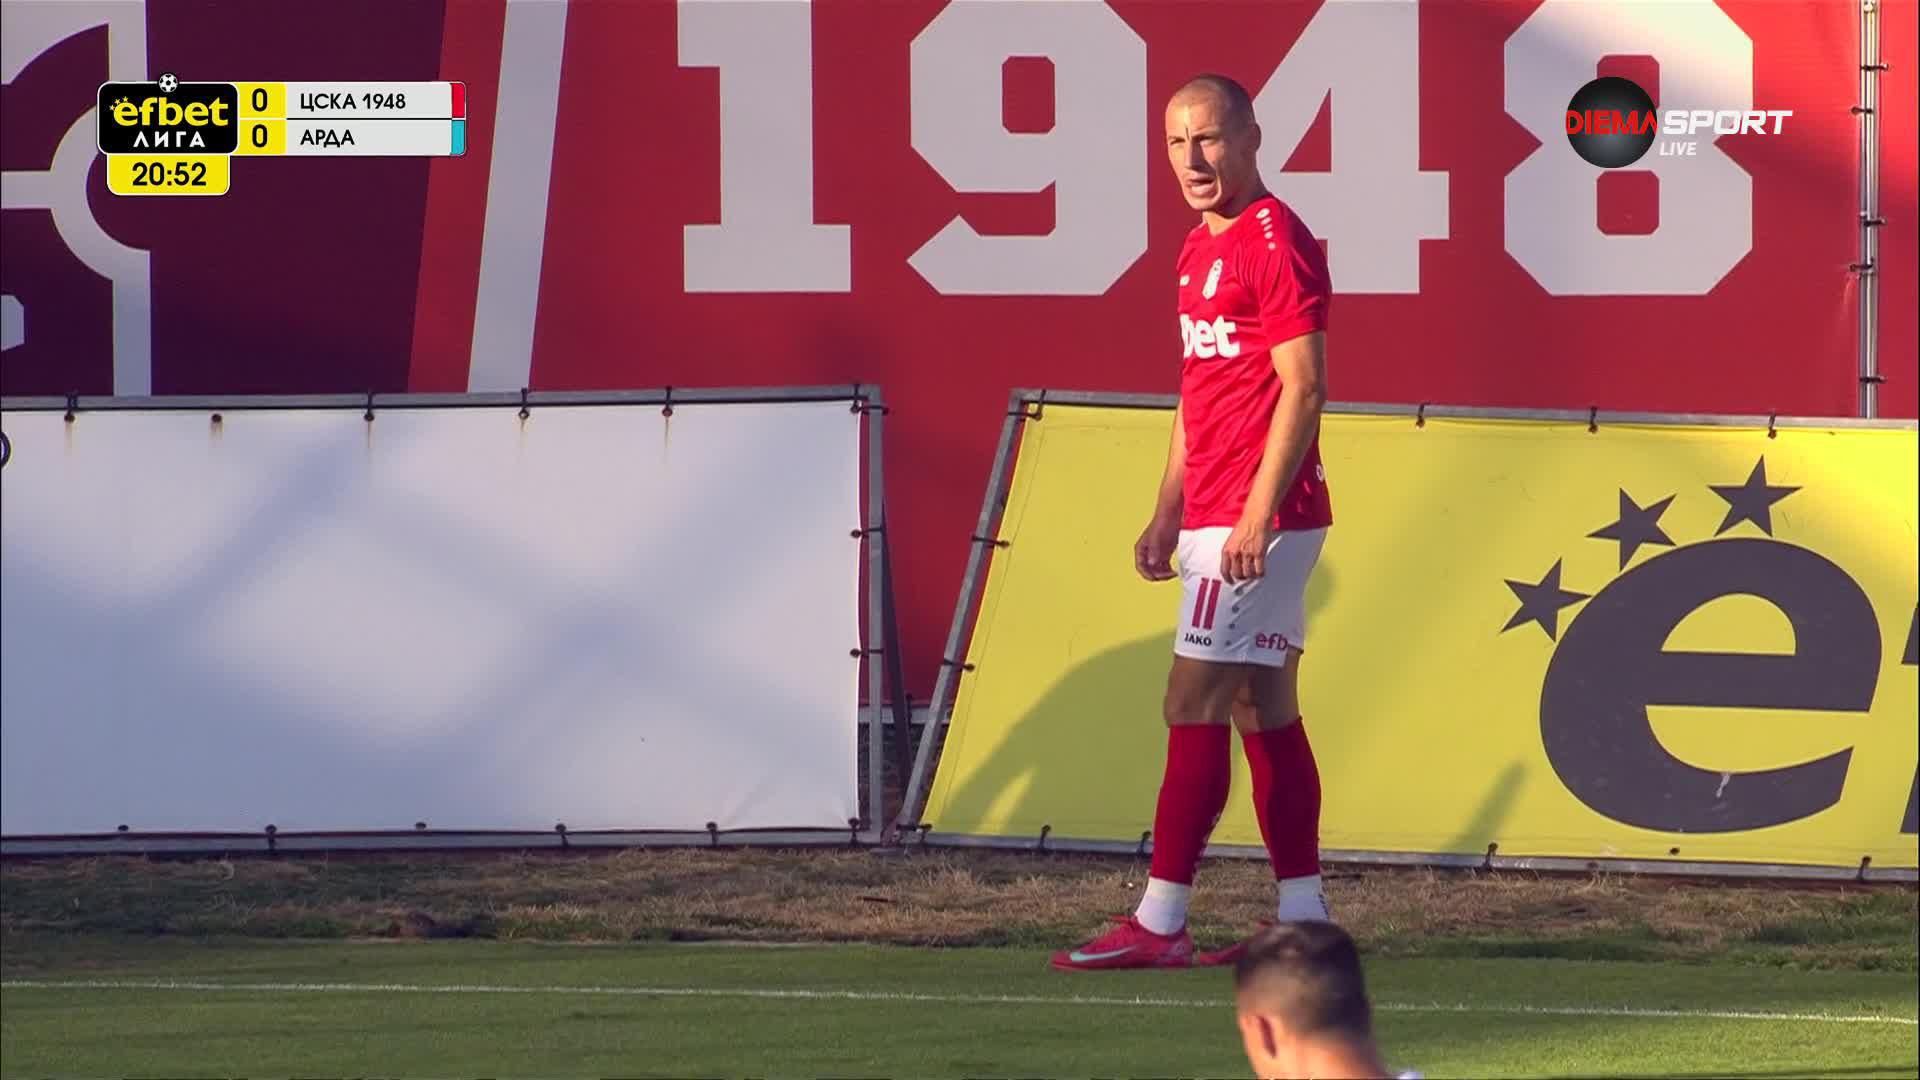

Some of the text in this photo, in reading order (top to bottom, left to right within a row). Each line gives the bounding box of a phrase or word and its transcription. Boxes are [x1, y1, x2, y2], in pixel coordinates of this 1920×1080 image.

[677, 0, 1753, 296] 1948
[1184, 632, 1213, 647] JAKO
[1191, 577, 1222, 630] 11
[1540, 537, 1918, 834] e
